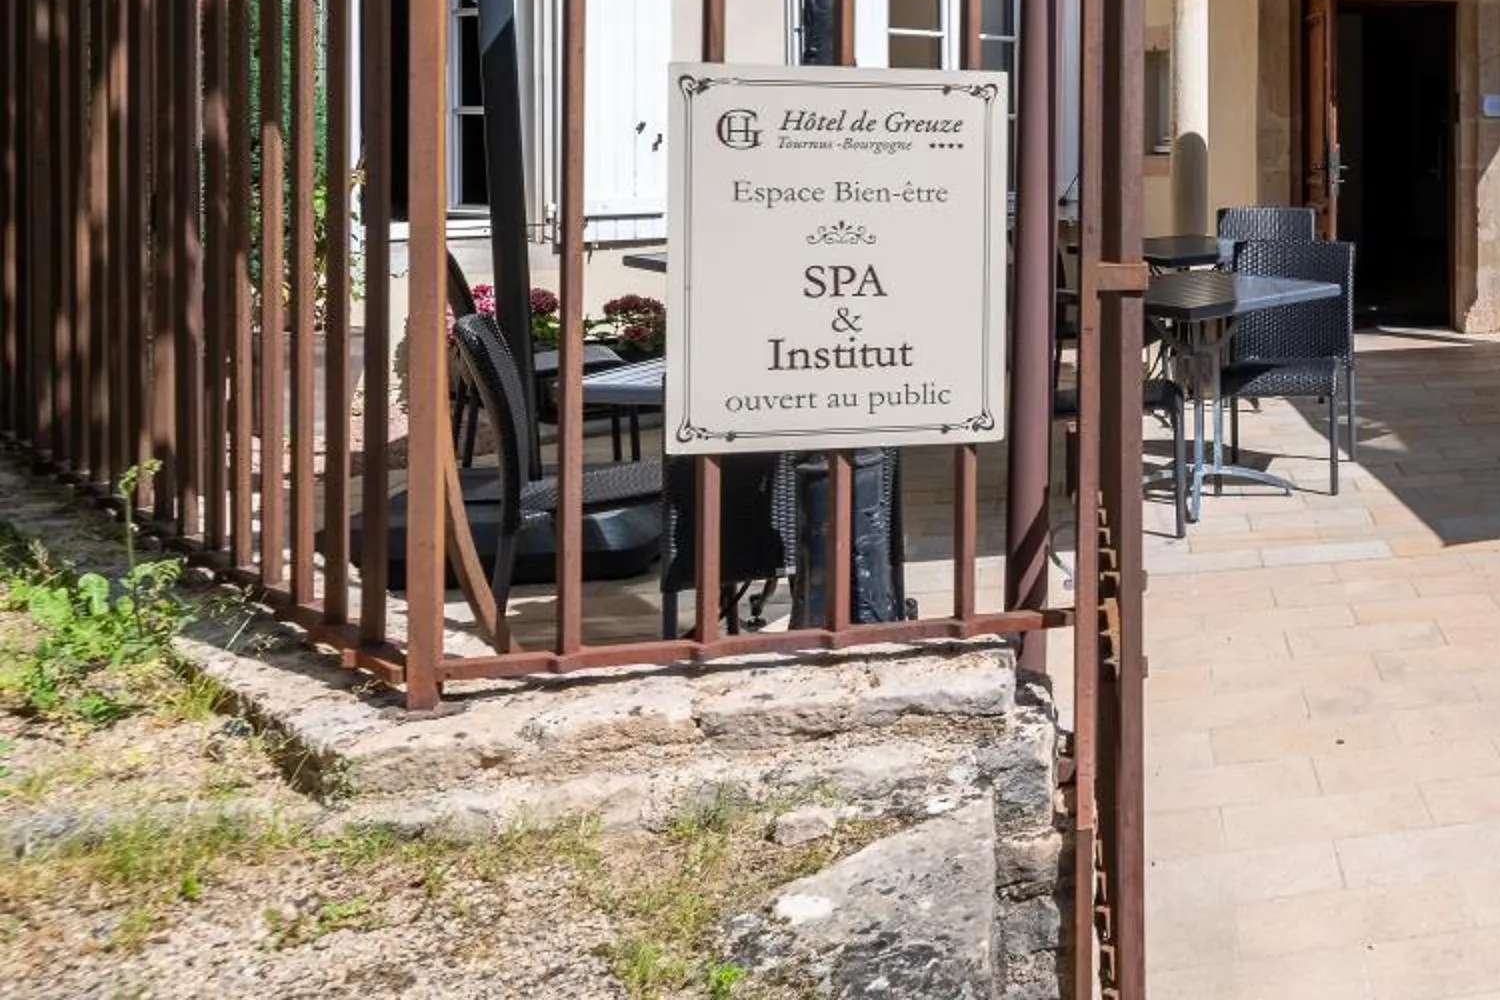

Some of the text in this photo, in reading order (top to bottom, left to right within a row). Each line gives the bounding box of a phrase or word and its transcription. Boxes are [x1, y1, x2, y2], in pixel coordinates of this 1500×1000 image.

[779, 109, 964, 134] Hôtel de Greuze
[778, 136, 833, 149] Tournus
[733, 180, 949, 209] Espace Bien-être
[803, 264, 888, 299] SPA
[831, 307, 863, 333] &
[767, 336, 913, 371] Institut
[724, 382, 951, 415] ouvert au public
